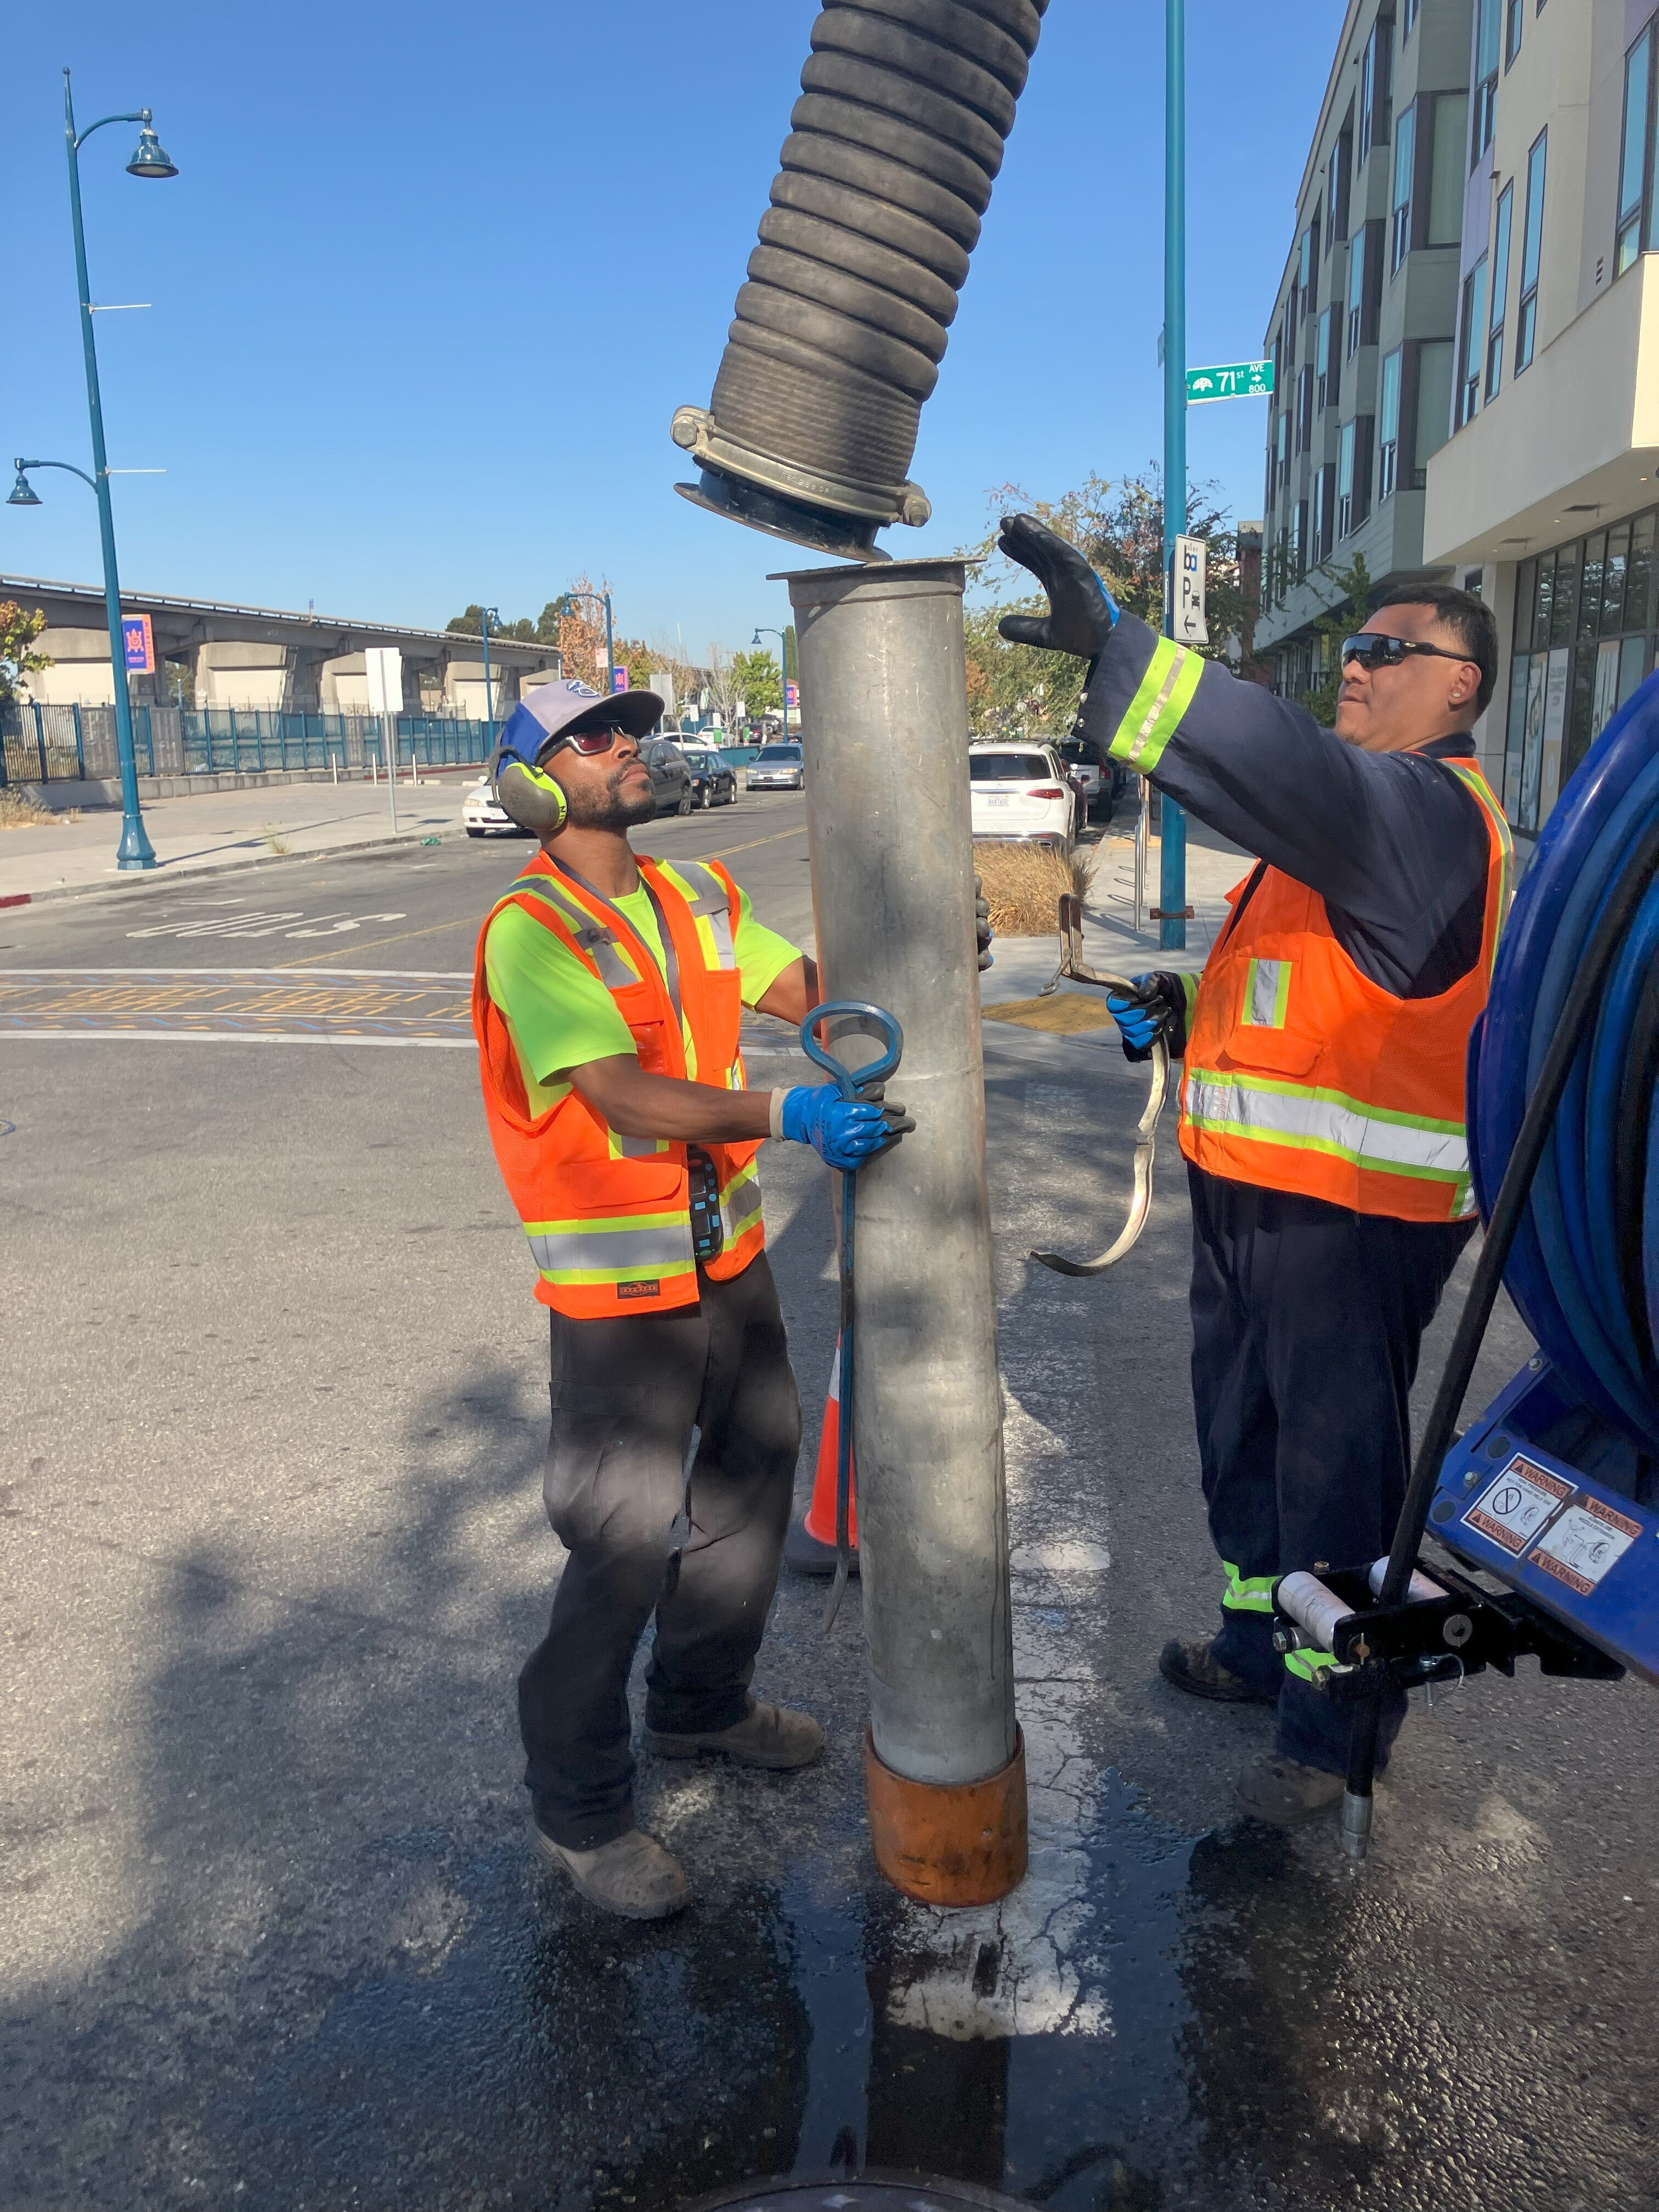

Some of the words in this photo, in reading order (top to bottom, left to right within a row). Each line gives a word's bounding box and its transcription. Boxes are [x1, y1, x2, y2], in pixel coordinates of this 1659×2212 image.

[1249, 363, 1265, 373] AVE
[1248, 383, 1266, 393] 800
[1183, 576, 1190, 609] P
[1525, 1468, 1567, 1496] WARNING
[1482, 1518, 1523, 1548] WARNING
[1589, 1501, 1641, 1536] WARNING
[1541, 1558, 1592, 1593] WARNING
